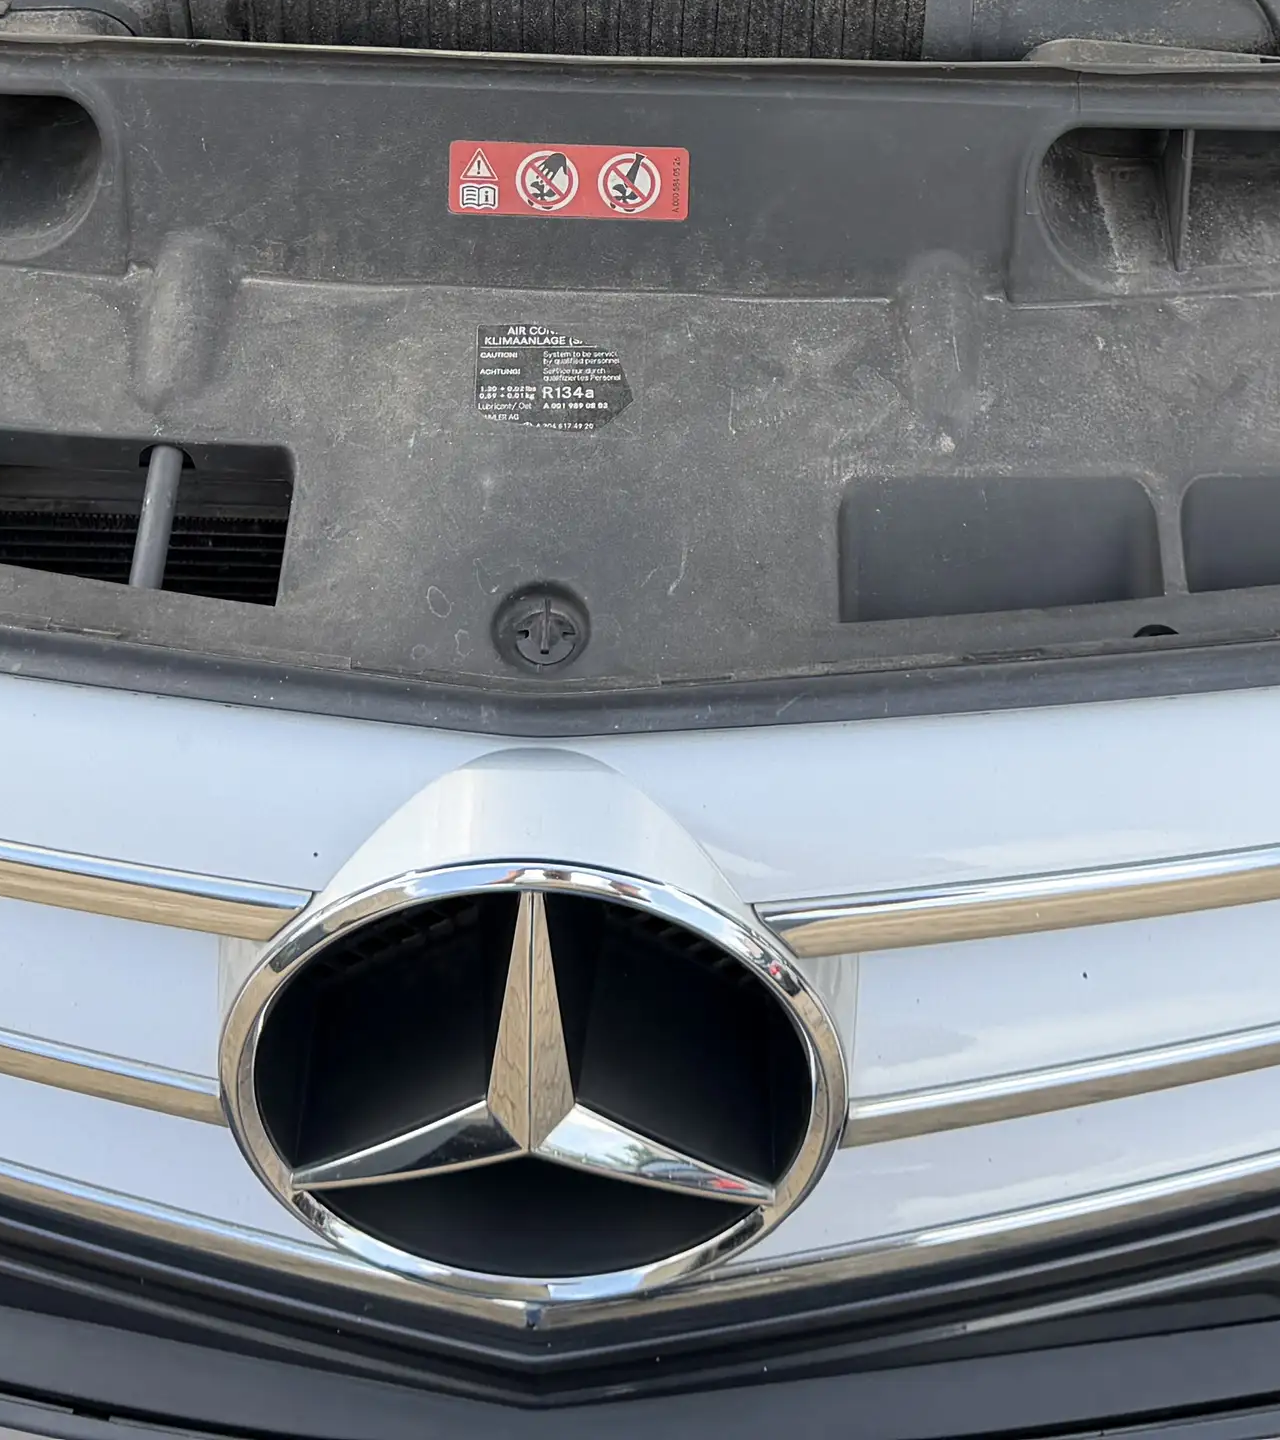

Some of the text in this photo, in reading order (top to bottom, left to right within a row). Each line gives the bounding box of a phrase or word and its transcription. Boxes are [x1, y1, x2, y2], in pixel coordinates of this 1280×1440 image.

[507, 326, 526, 335] AIR
[484, 336, 566, 345] KLIMAANLAGE
[543, 351, 571, 359] System
[590, 374, 621, 382] Personal
[542, 386, 594, 399] R134a
